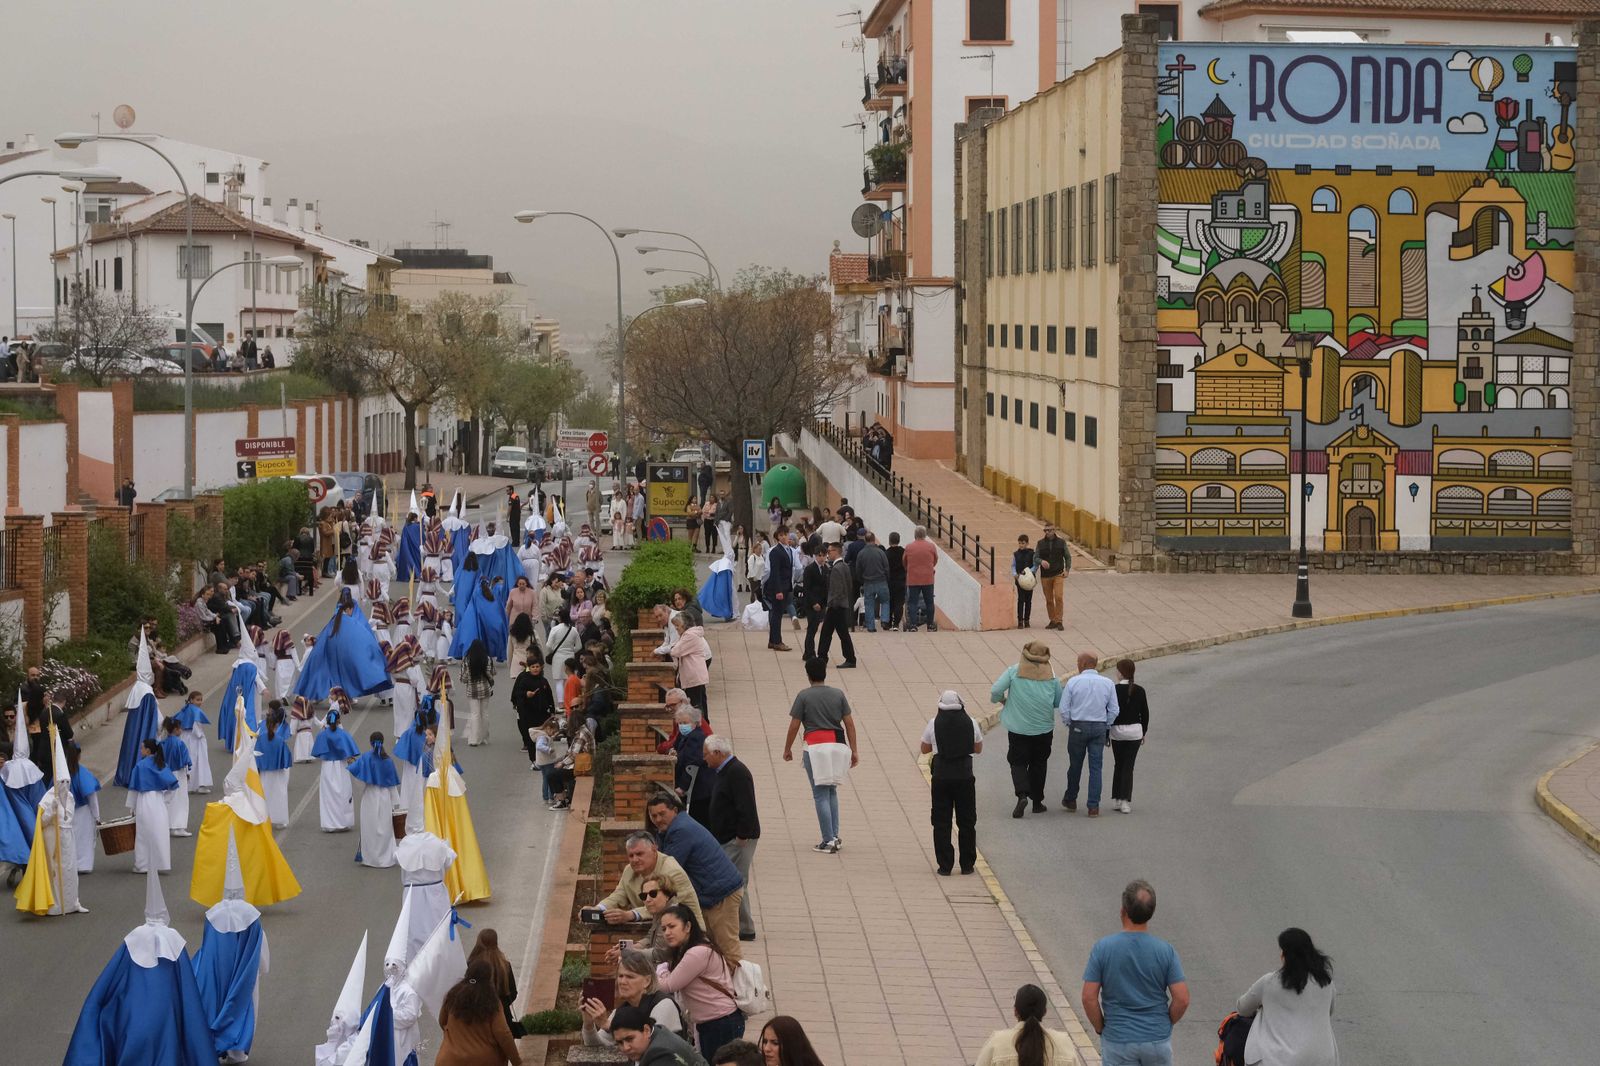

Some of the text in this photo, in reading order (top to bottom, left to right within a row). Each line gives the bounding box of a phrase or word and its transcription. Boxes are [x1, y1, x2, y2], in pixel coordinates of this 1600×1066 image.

[1249, 54, 1442, 124] RONDA
[1250, 132, 1441, 150] CIUDAD SOÑADA
[245, 440, 286, 449] DISPONIBLE
[257, 460, 286, 469] Supeco
[652, 497, 685, 507] Supeco
